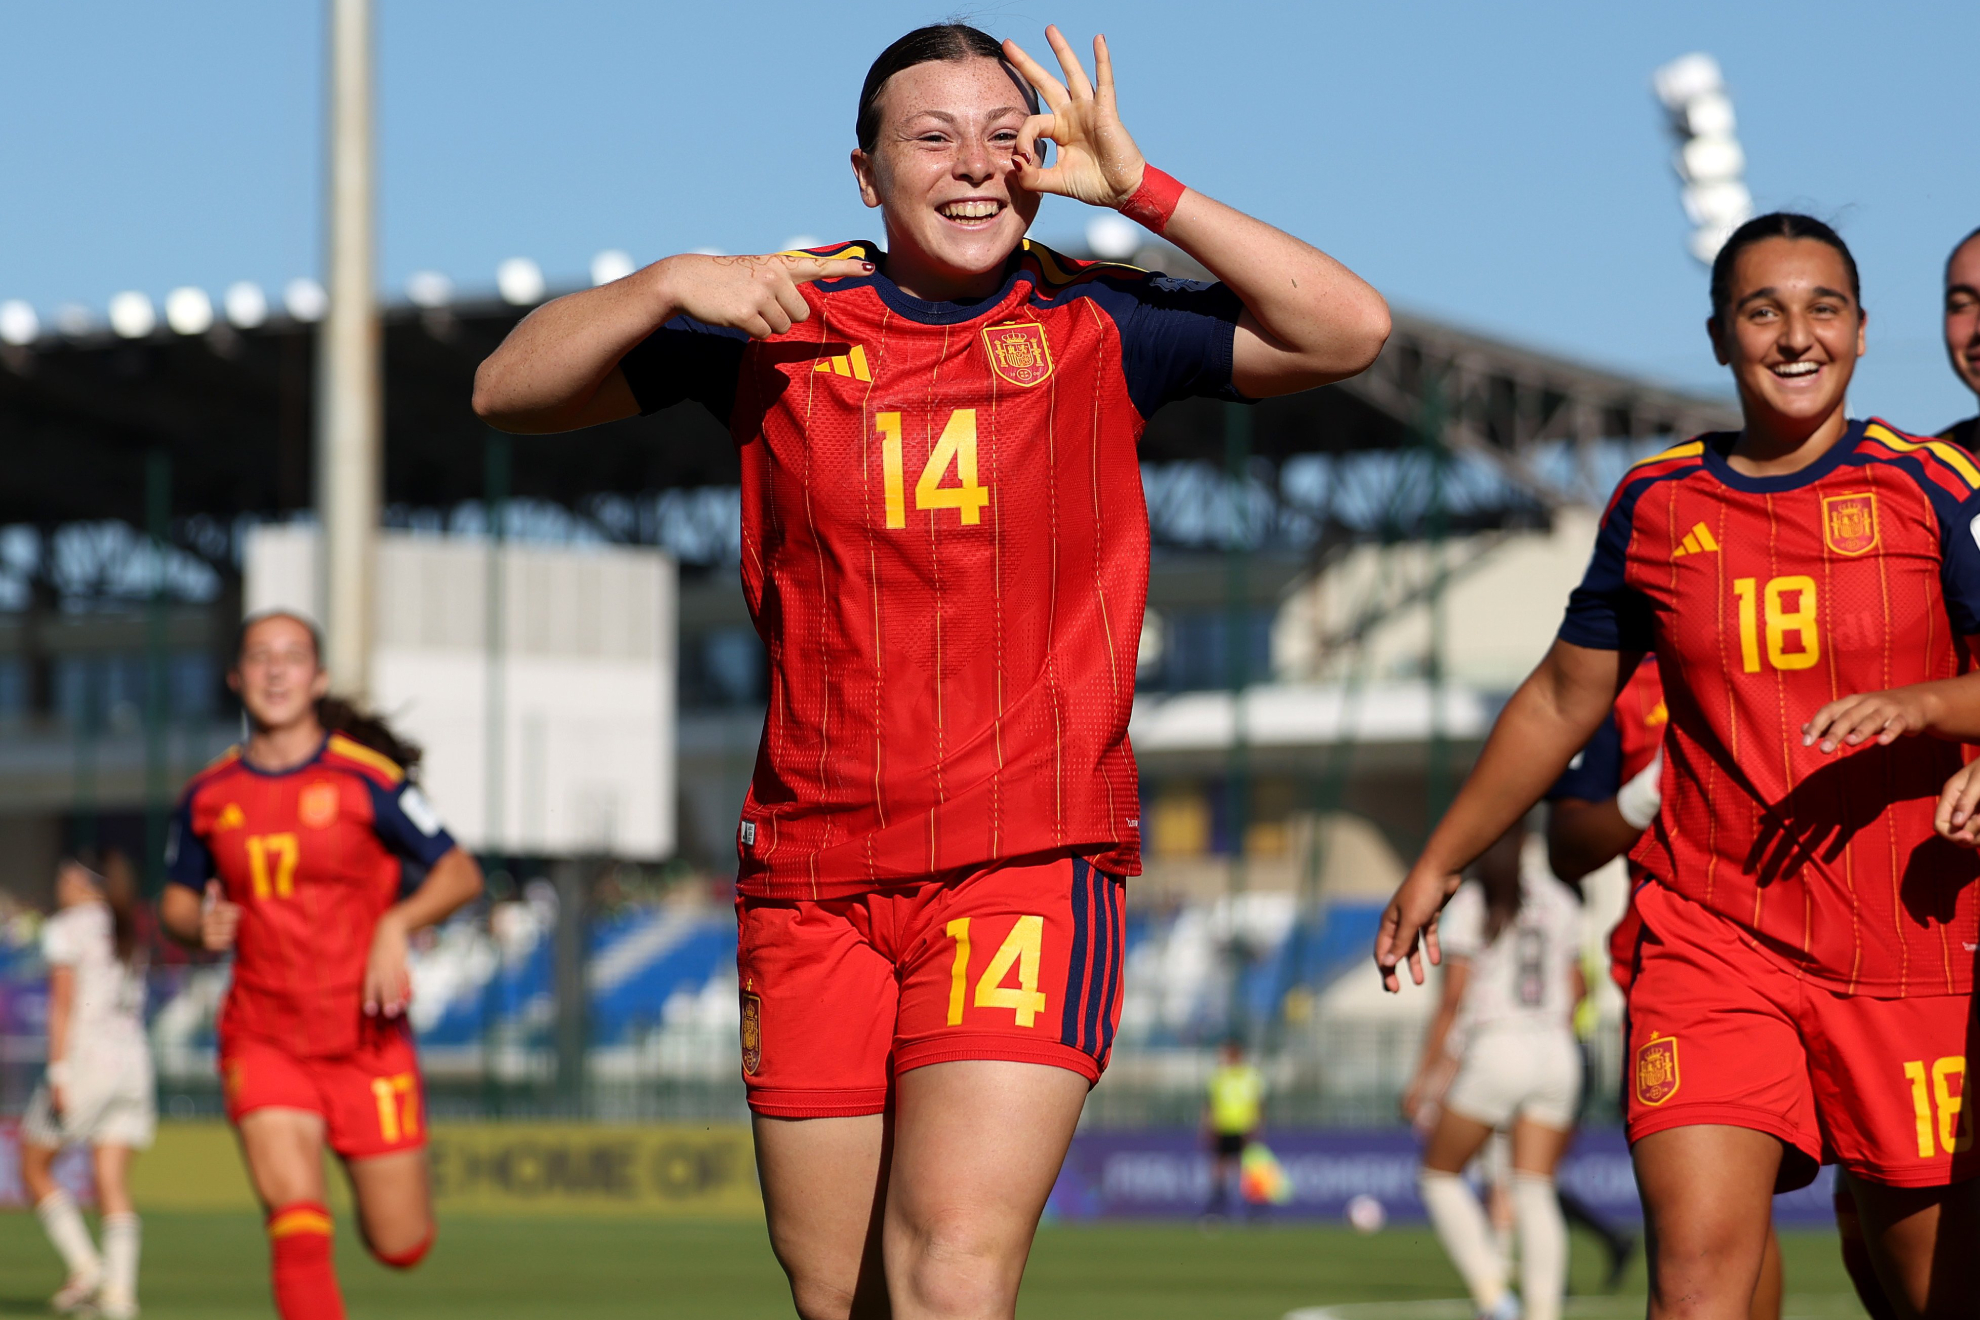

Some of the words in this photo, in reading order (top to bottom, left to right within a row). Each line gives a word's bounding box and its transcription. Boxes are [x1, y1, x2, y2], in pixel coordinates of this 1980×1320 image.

[875, 408, 989, 529] 14
[1733, 575, 1820, 673] 18
[246, 832, 298, 900] 17
[945, 915, 1046, 1028] 14
[370, 1074, 419, 1144] 17
[1903, 1055, 1974, 1158] 18
[463, 1145, 636, 1197] HOME
[654, 1145, 738, 1198] OF
